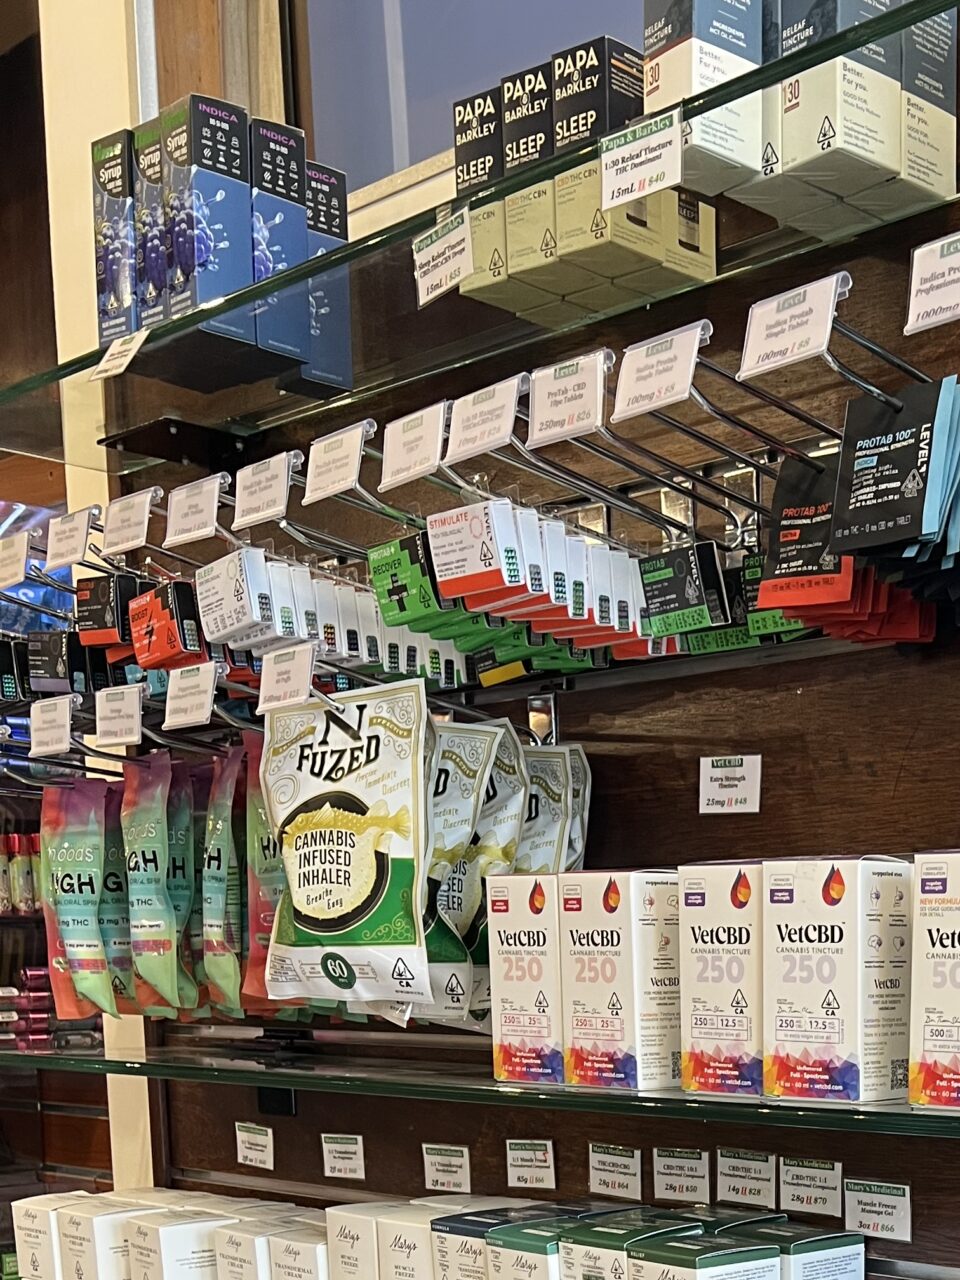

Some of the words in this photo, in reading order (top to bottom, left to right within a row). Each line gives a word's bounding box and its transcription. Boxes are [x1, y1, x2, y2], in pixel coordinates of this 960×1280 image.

[555, 47, 598, 80] PAPA
[504, 71, 547, 103] PAPA
[555, 74, 600, 101] BARKLEY
[198, 103, 238, 123] INDICA
[455, 95, 495, 127] PAPA
[505, 98, 549, 123] BARKLEY
[259, 127, 297, 147] INDICA
[456, 121, 496, 146] BARKLEY
[556, 110, 596, 140] SLEEP
[603, 137, 624, 151] Papa
[626, 131, 633, 142] &
[635, 117, 672, 139] Barkley
[167, 133, 187, 152] Syrup
[505, 132, 545, 162] SLEEP
[100, 164, 121, 183] Syrup
[457, 155, 493, 184] SLEEP
[429, 512, 469, 530] STIMULATE
[297, 734, 380, 784] FUZED
[295, 830, 356, 850] CANNABIS
[299, 849, 352, 868] INFUSED
[298, 869, 351, 889] INHALER
[327, 959, 346, 978] 60
